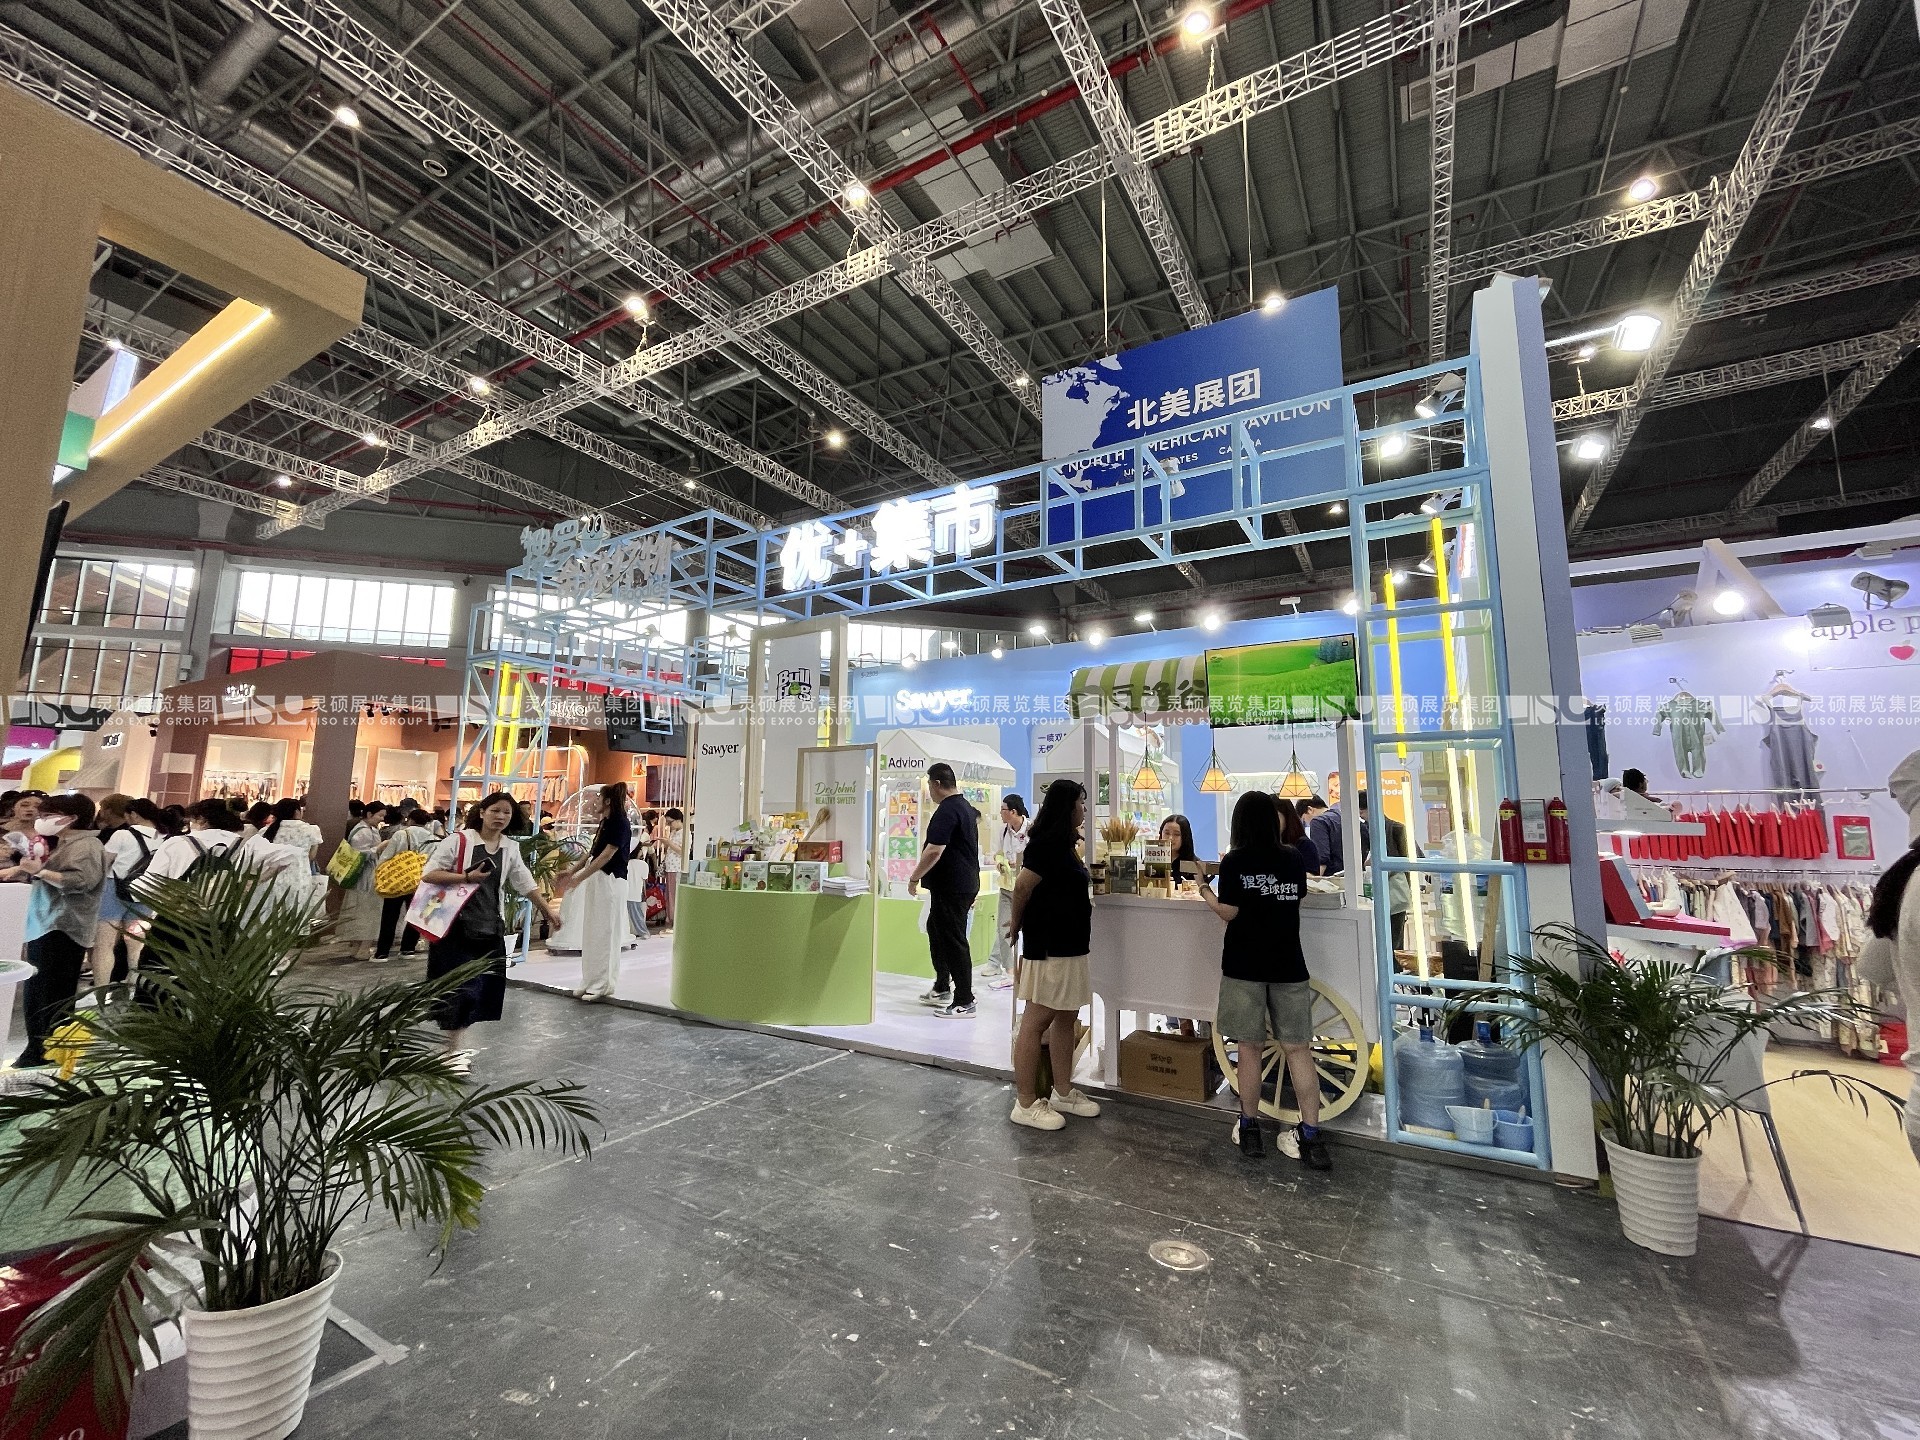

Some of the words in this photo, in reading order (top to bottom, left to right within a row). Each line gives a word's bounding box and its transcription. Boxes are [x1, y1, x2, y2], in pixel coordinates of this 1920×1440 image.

[1127, 368, 1261, 430] 北美展团
[1147, 423, 1228, 453] MERICAN
[1811, 613, 1896, 641] apple
[777, 668, 811, 686] Bull
[1038, 733, 1067, 742] 一喷双
[702, 742, 739, 758] Sawyer
[888, 757, 925, 768] Advion
